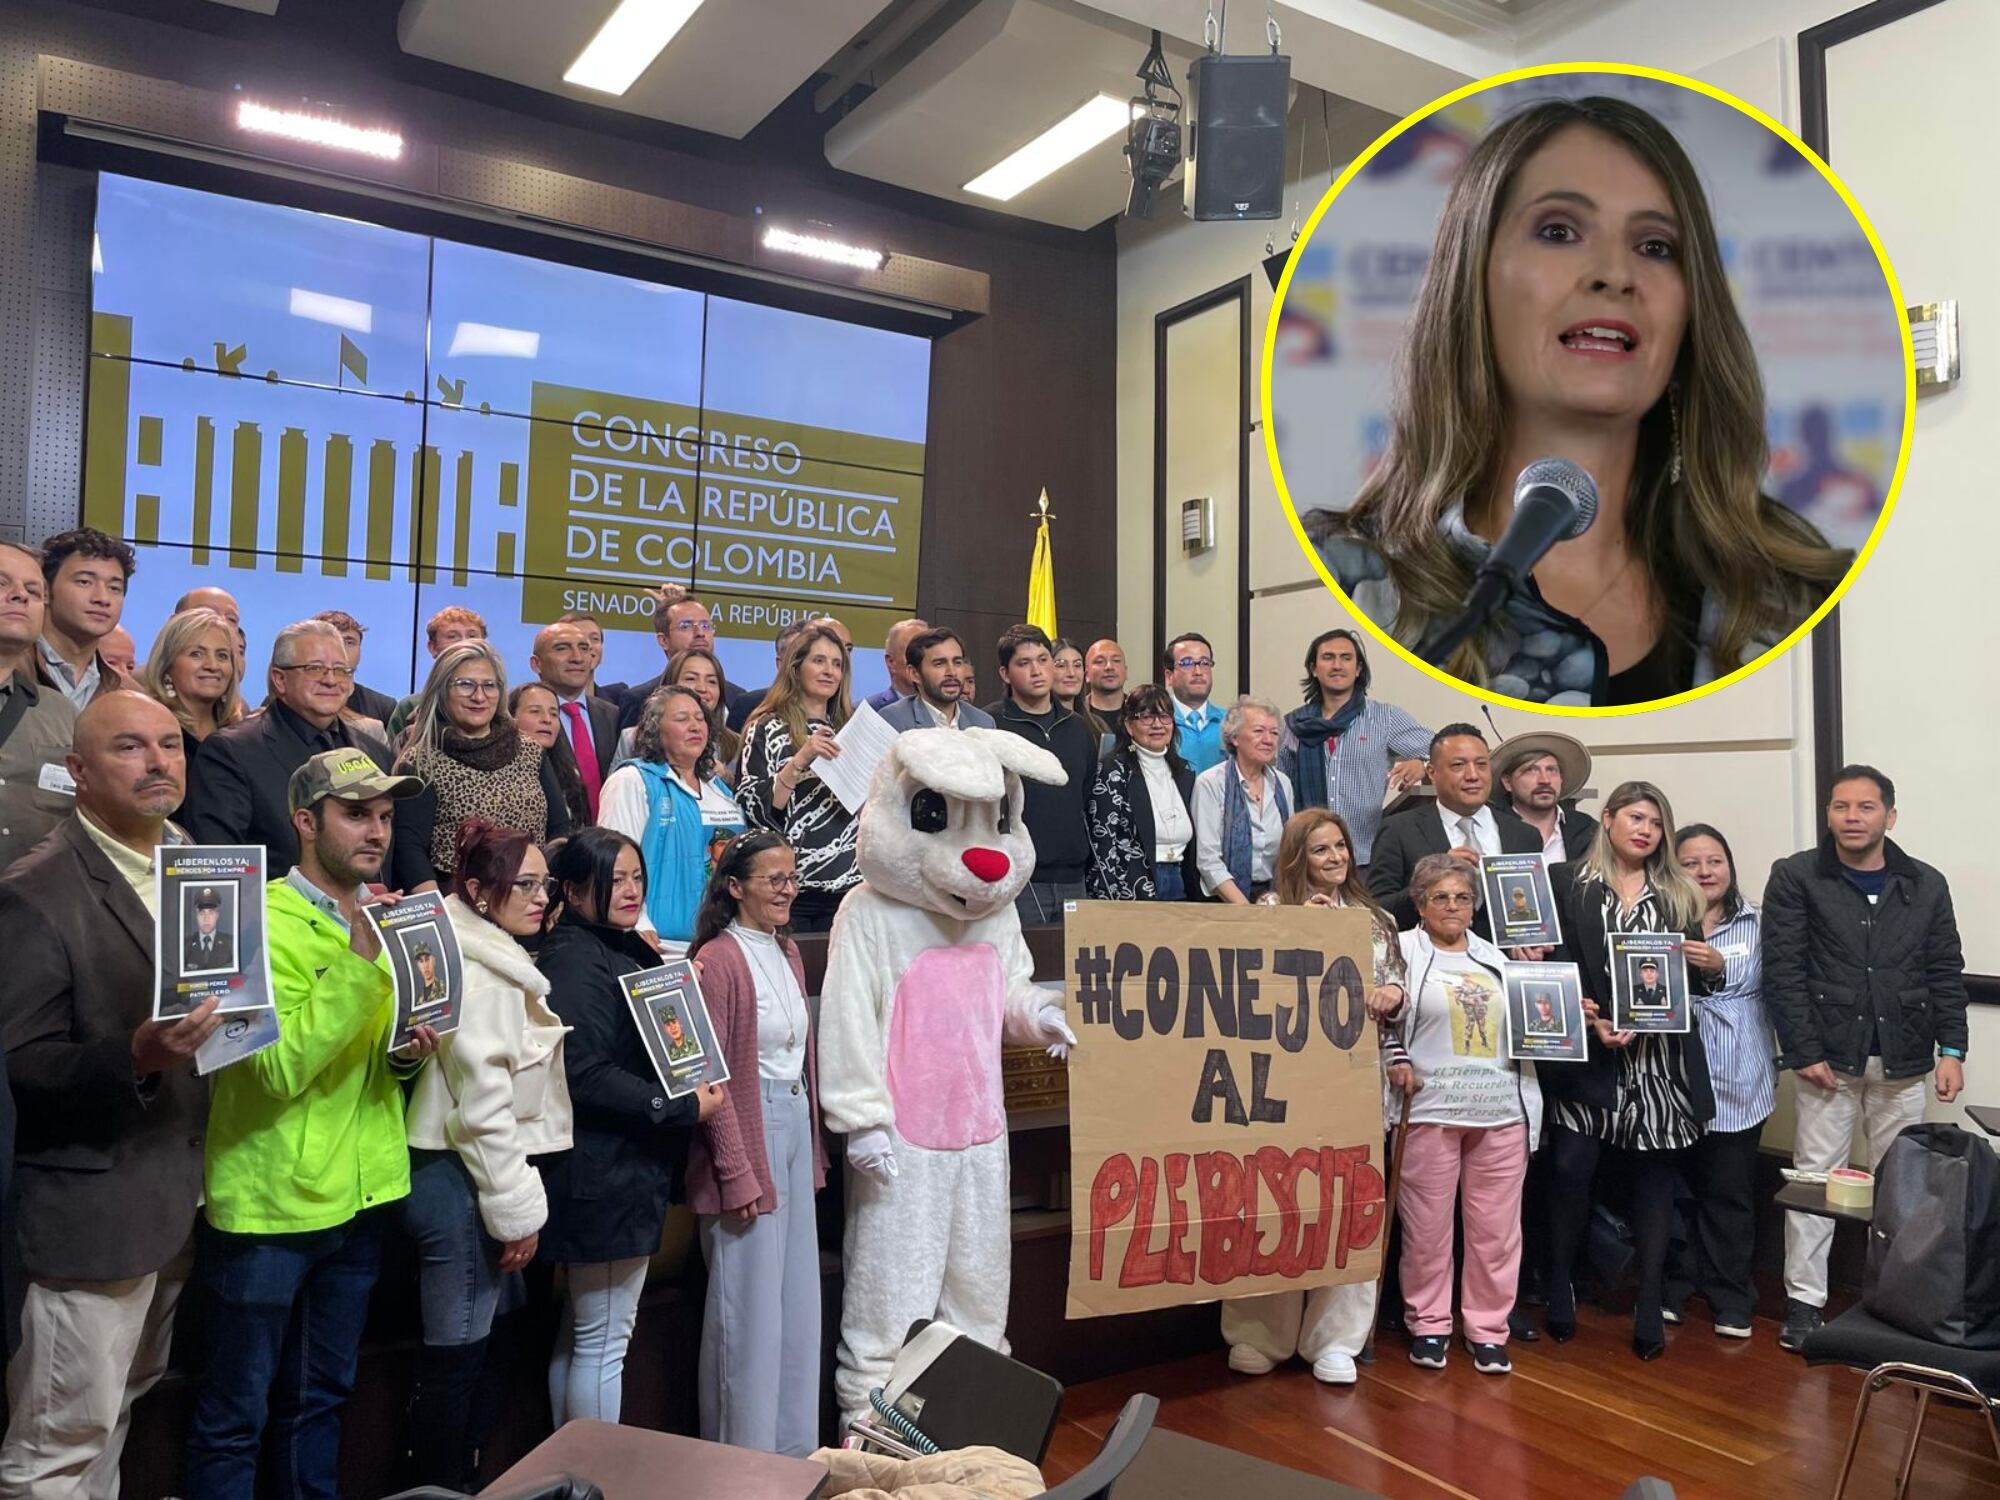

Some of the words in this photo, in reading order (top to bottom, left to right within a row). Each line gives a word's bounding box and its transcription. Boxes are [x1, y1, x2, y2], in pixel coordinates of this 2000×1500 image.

[572, 411, 801, 475] CONGRESO
[569, 468, 623, 507] DE
[638, 477, 686, 515] LA
[703, 489, 896, 539] REPÚBLICA
[566, 525, 621, 562] DE
[635, 534, 842, 585] COLOMBIA
[563, 590, 656, 617] SENADO
[1074, 942, 1365, 1053] #CONEJO
[1191, 1048, 1288, 1126] AL
[1089, 1144, 1385, 1288] PLEBISCITO
